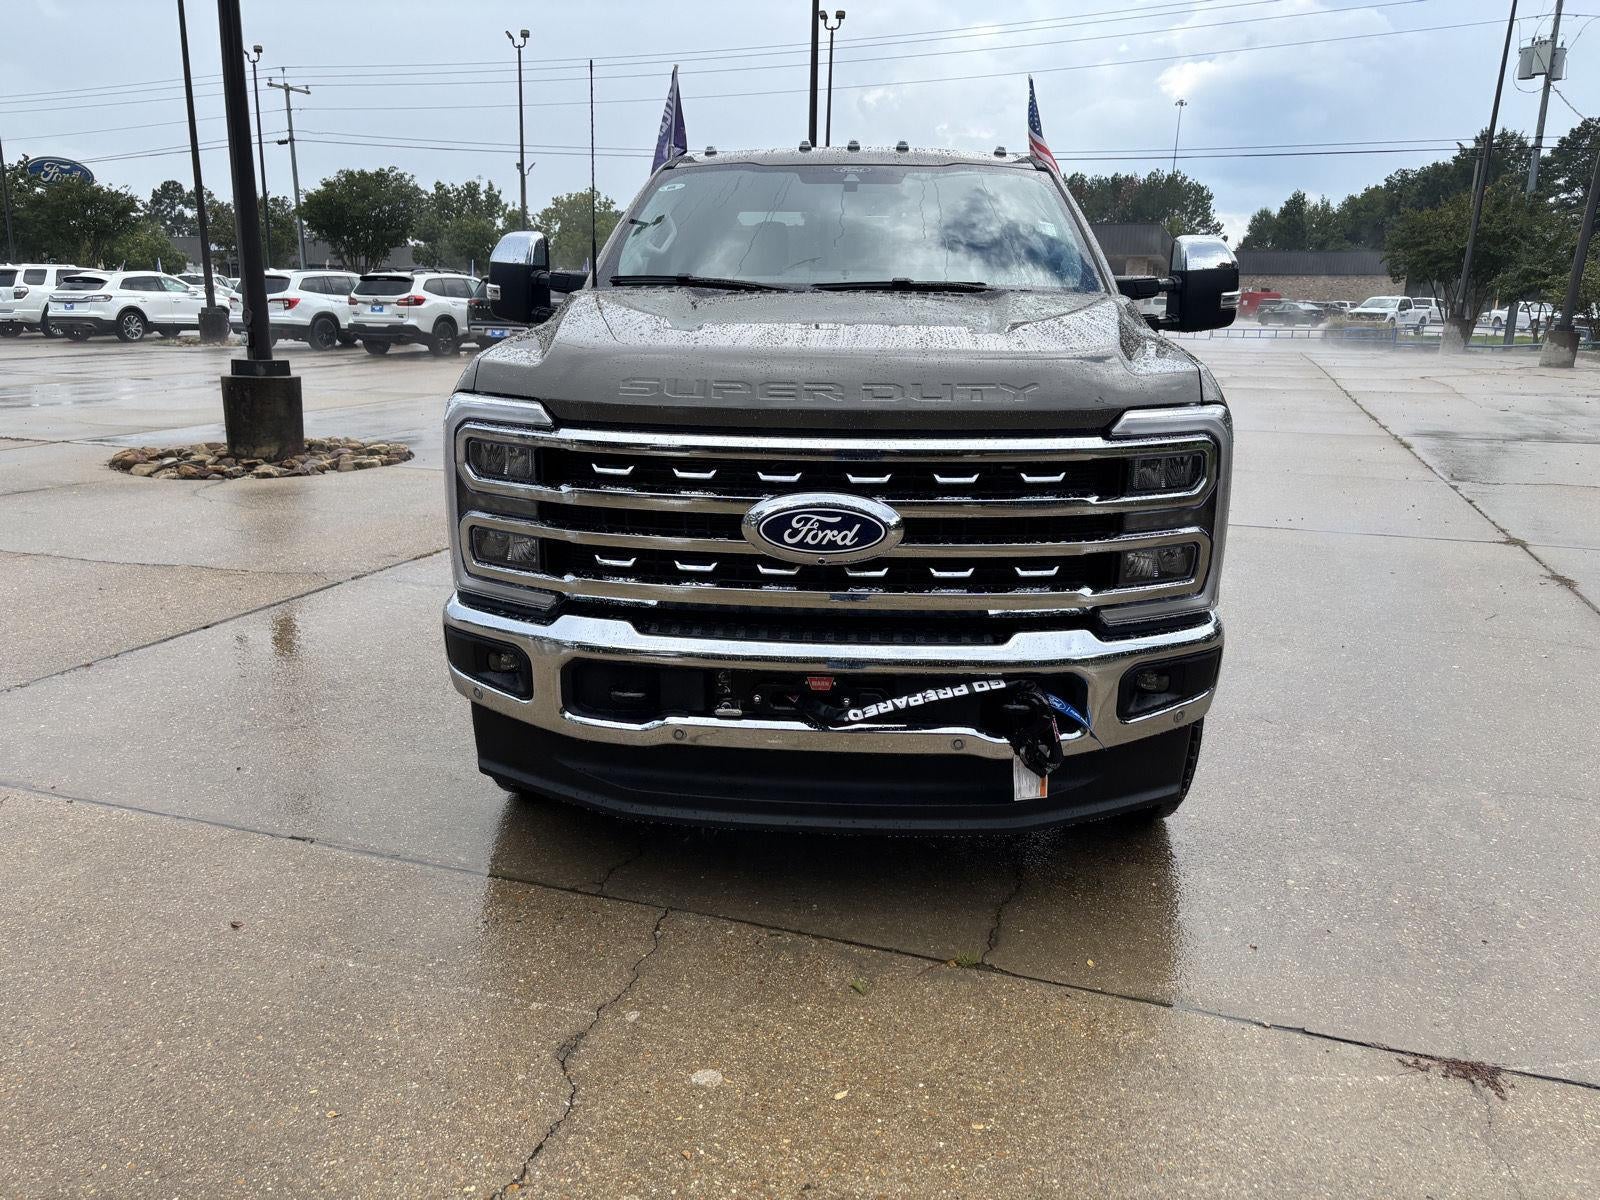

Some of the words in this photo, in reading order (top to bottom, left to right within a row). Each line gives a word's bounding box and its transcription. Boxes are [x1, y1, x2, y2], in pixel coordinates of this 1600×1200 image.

[41, 162, 80, 182] Ford
[618, 377, 843, 402] SUPER
[862, 383, 1039, 402] DUTY
[783, 514, 860, 546] Ford
[972, 679, 1007, 694] GO
[847, 684, 970, 721] PREPARED
